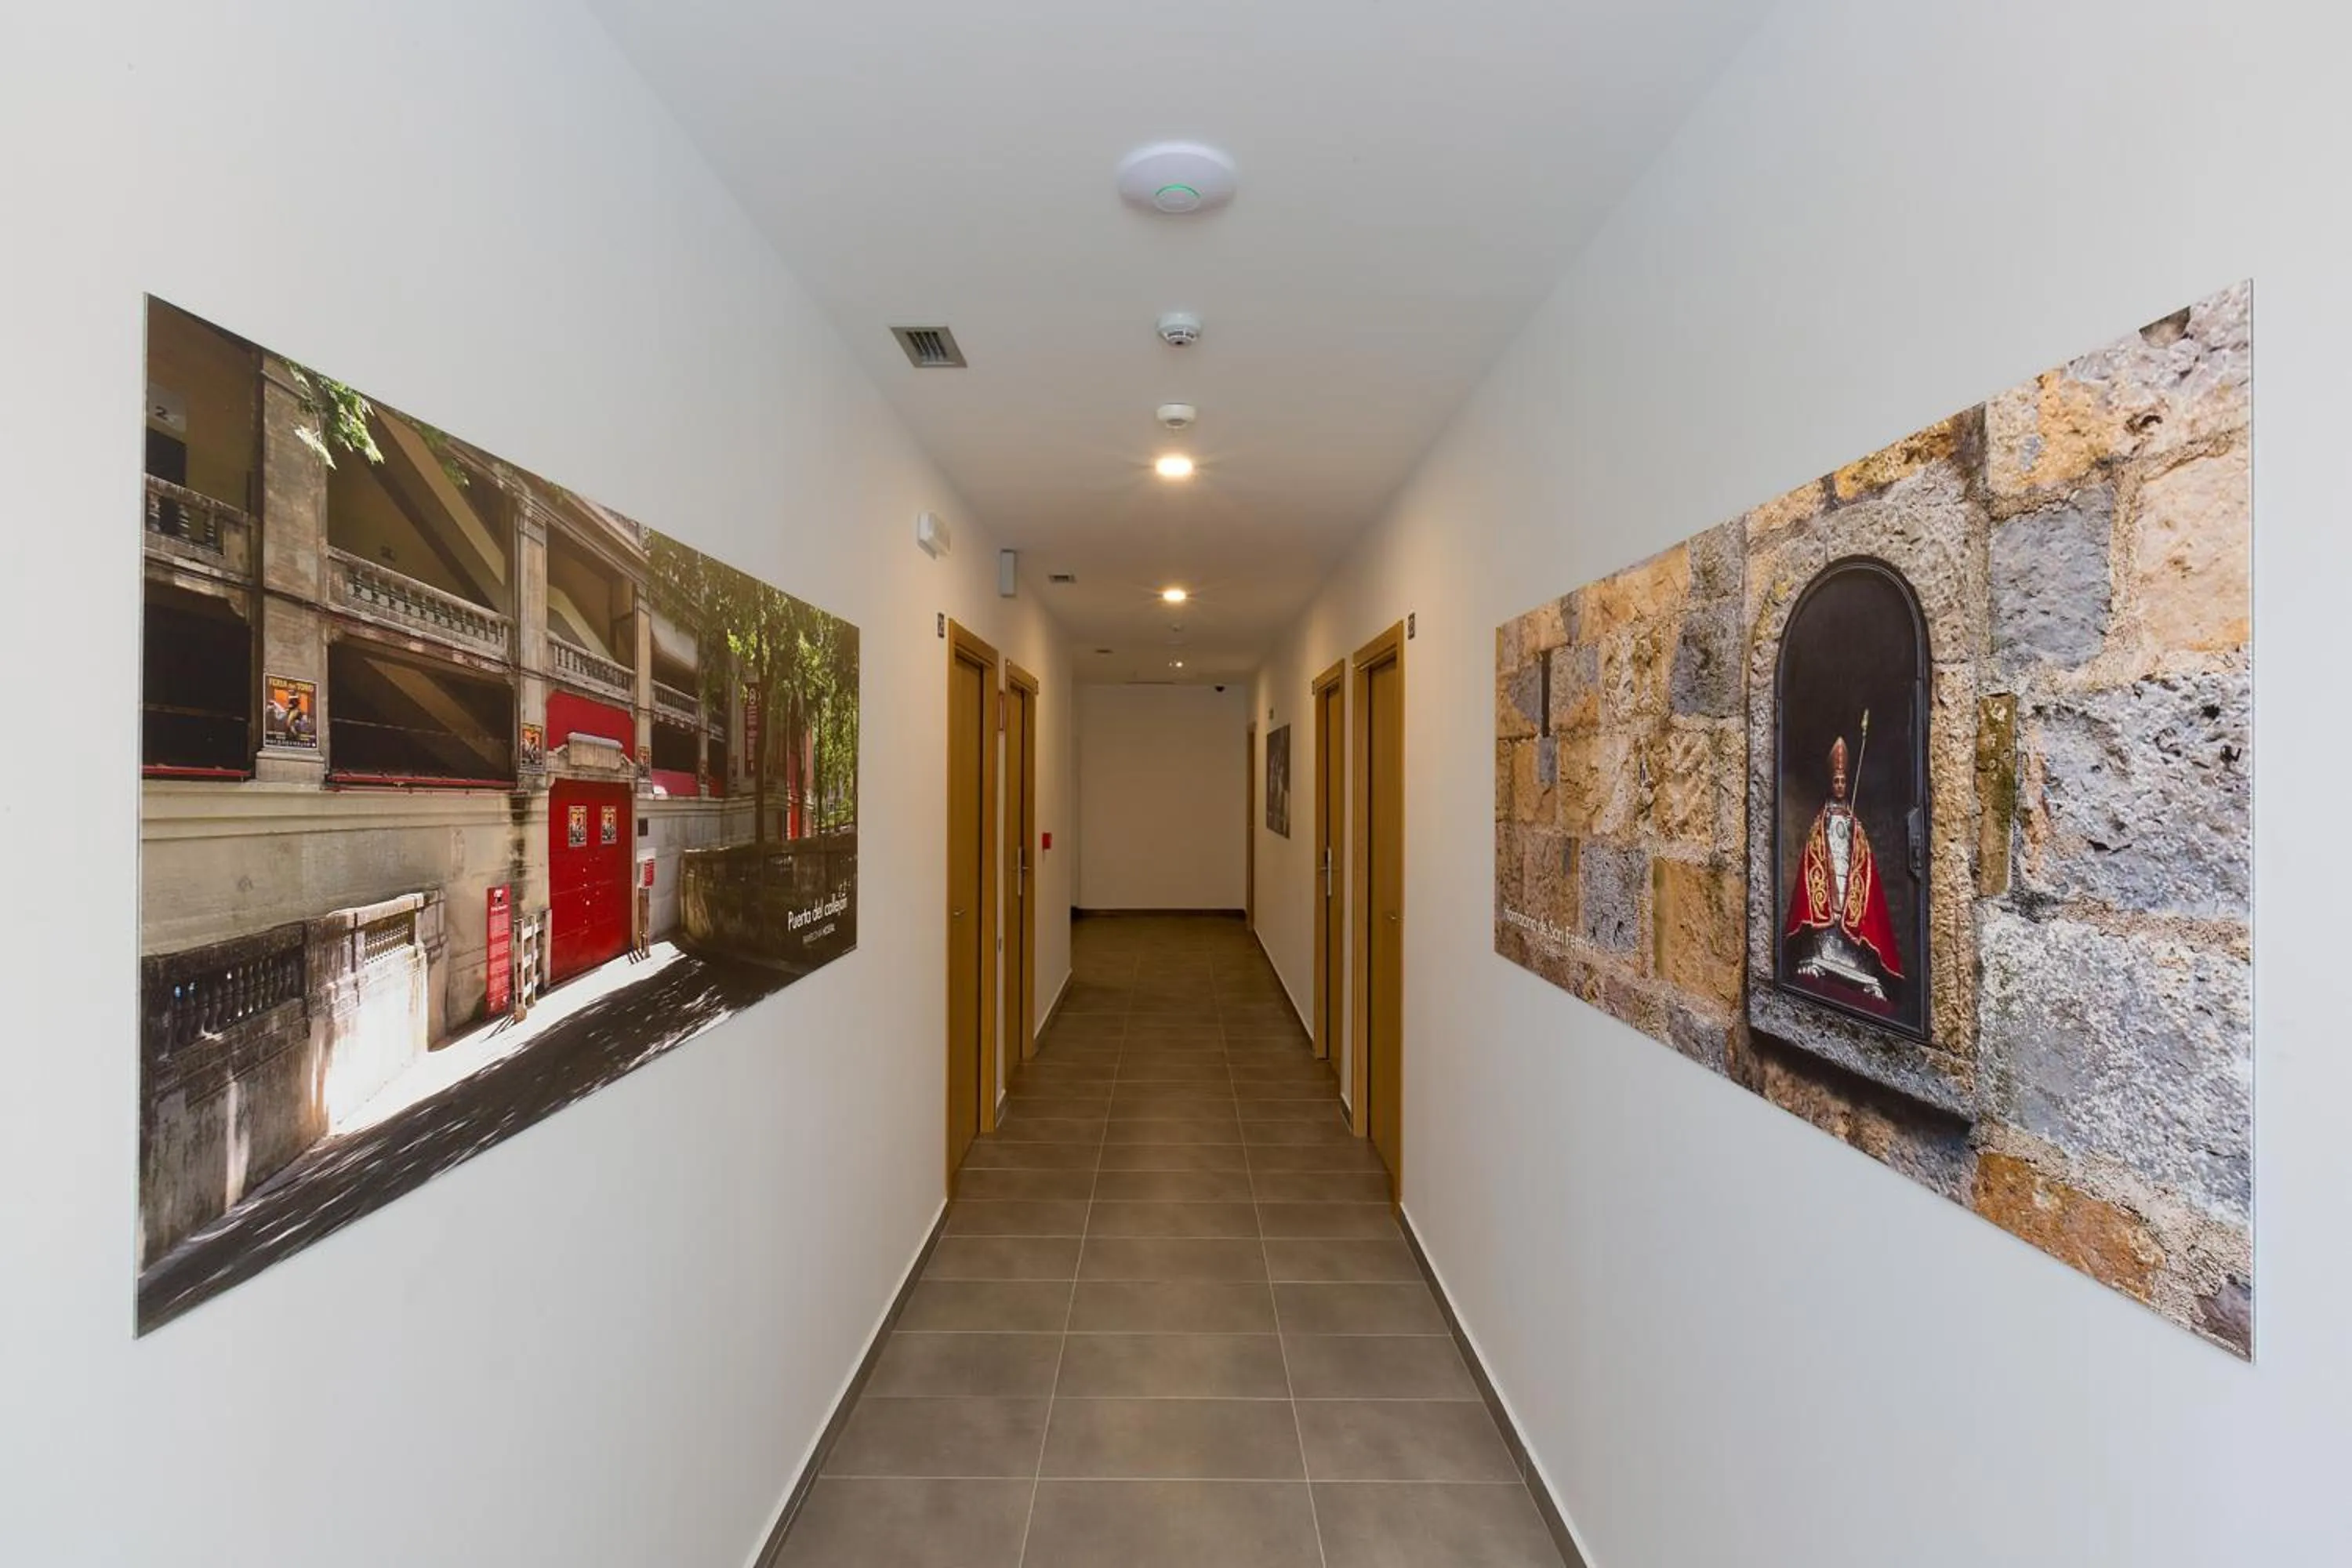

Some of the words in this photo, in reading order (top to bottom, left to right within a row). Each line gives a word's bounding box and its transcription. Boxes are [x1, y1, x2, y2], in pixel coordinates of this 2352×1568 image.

[788, 909, 811, 932] Puerta
[812, 897, 823, 920] del
[1548, 919, 1564, 944] San
